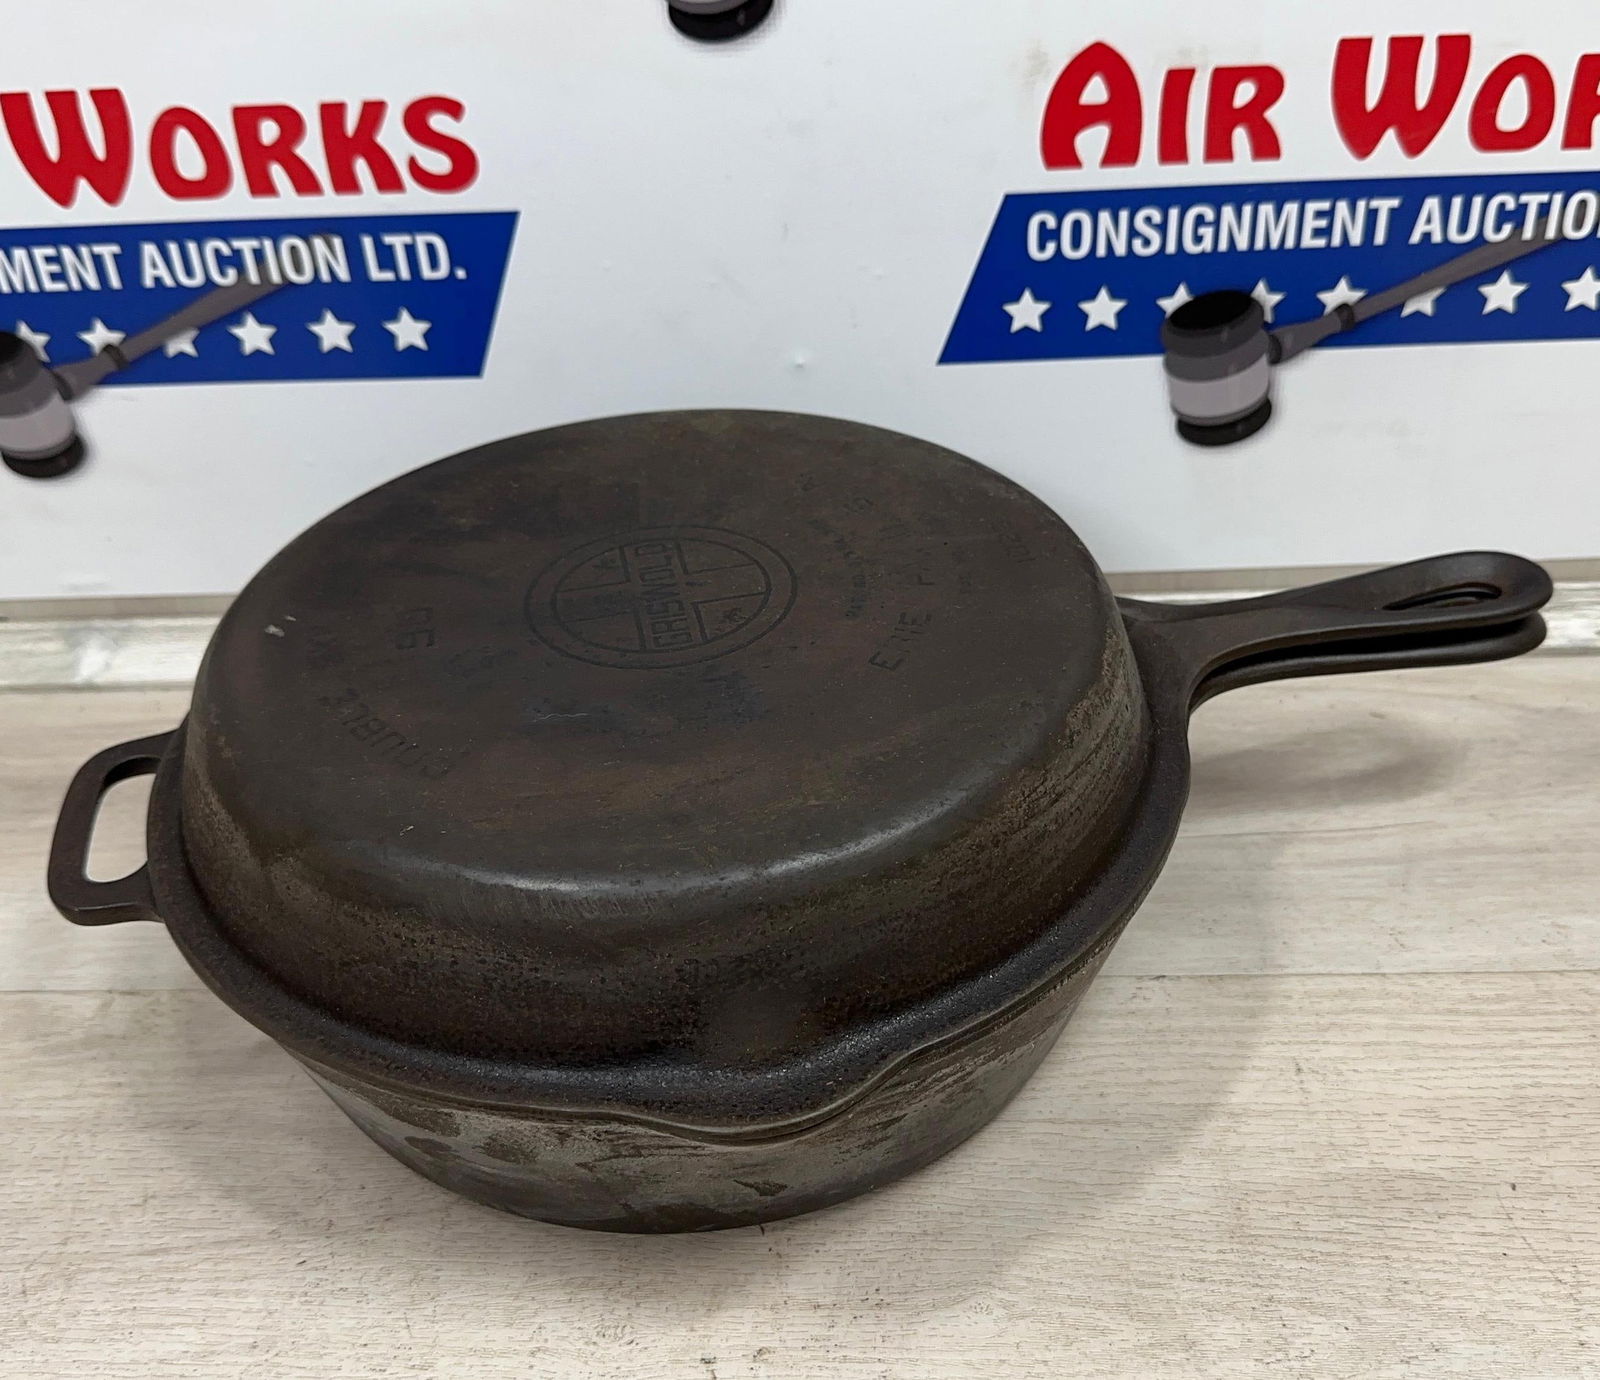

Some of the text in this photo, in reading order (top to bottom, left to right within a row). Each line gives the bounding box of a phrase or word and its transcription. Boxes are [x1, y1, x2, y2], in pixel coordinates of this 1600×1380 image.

[0, 88, 479, 208] WORKS
[1040, 41, 1286, 170] AIR
[0, 233, 467, 293] MENT AUCTION LTD.
[1026, 190, 1600, 262] CONSIGNMENT AUCTIO
[633, 542, 694, 648] GRISWOLD
